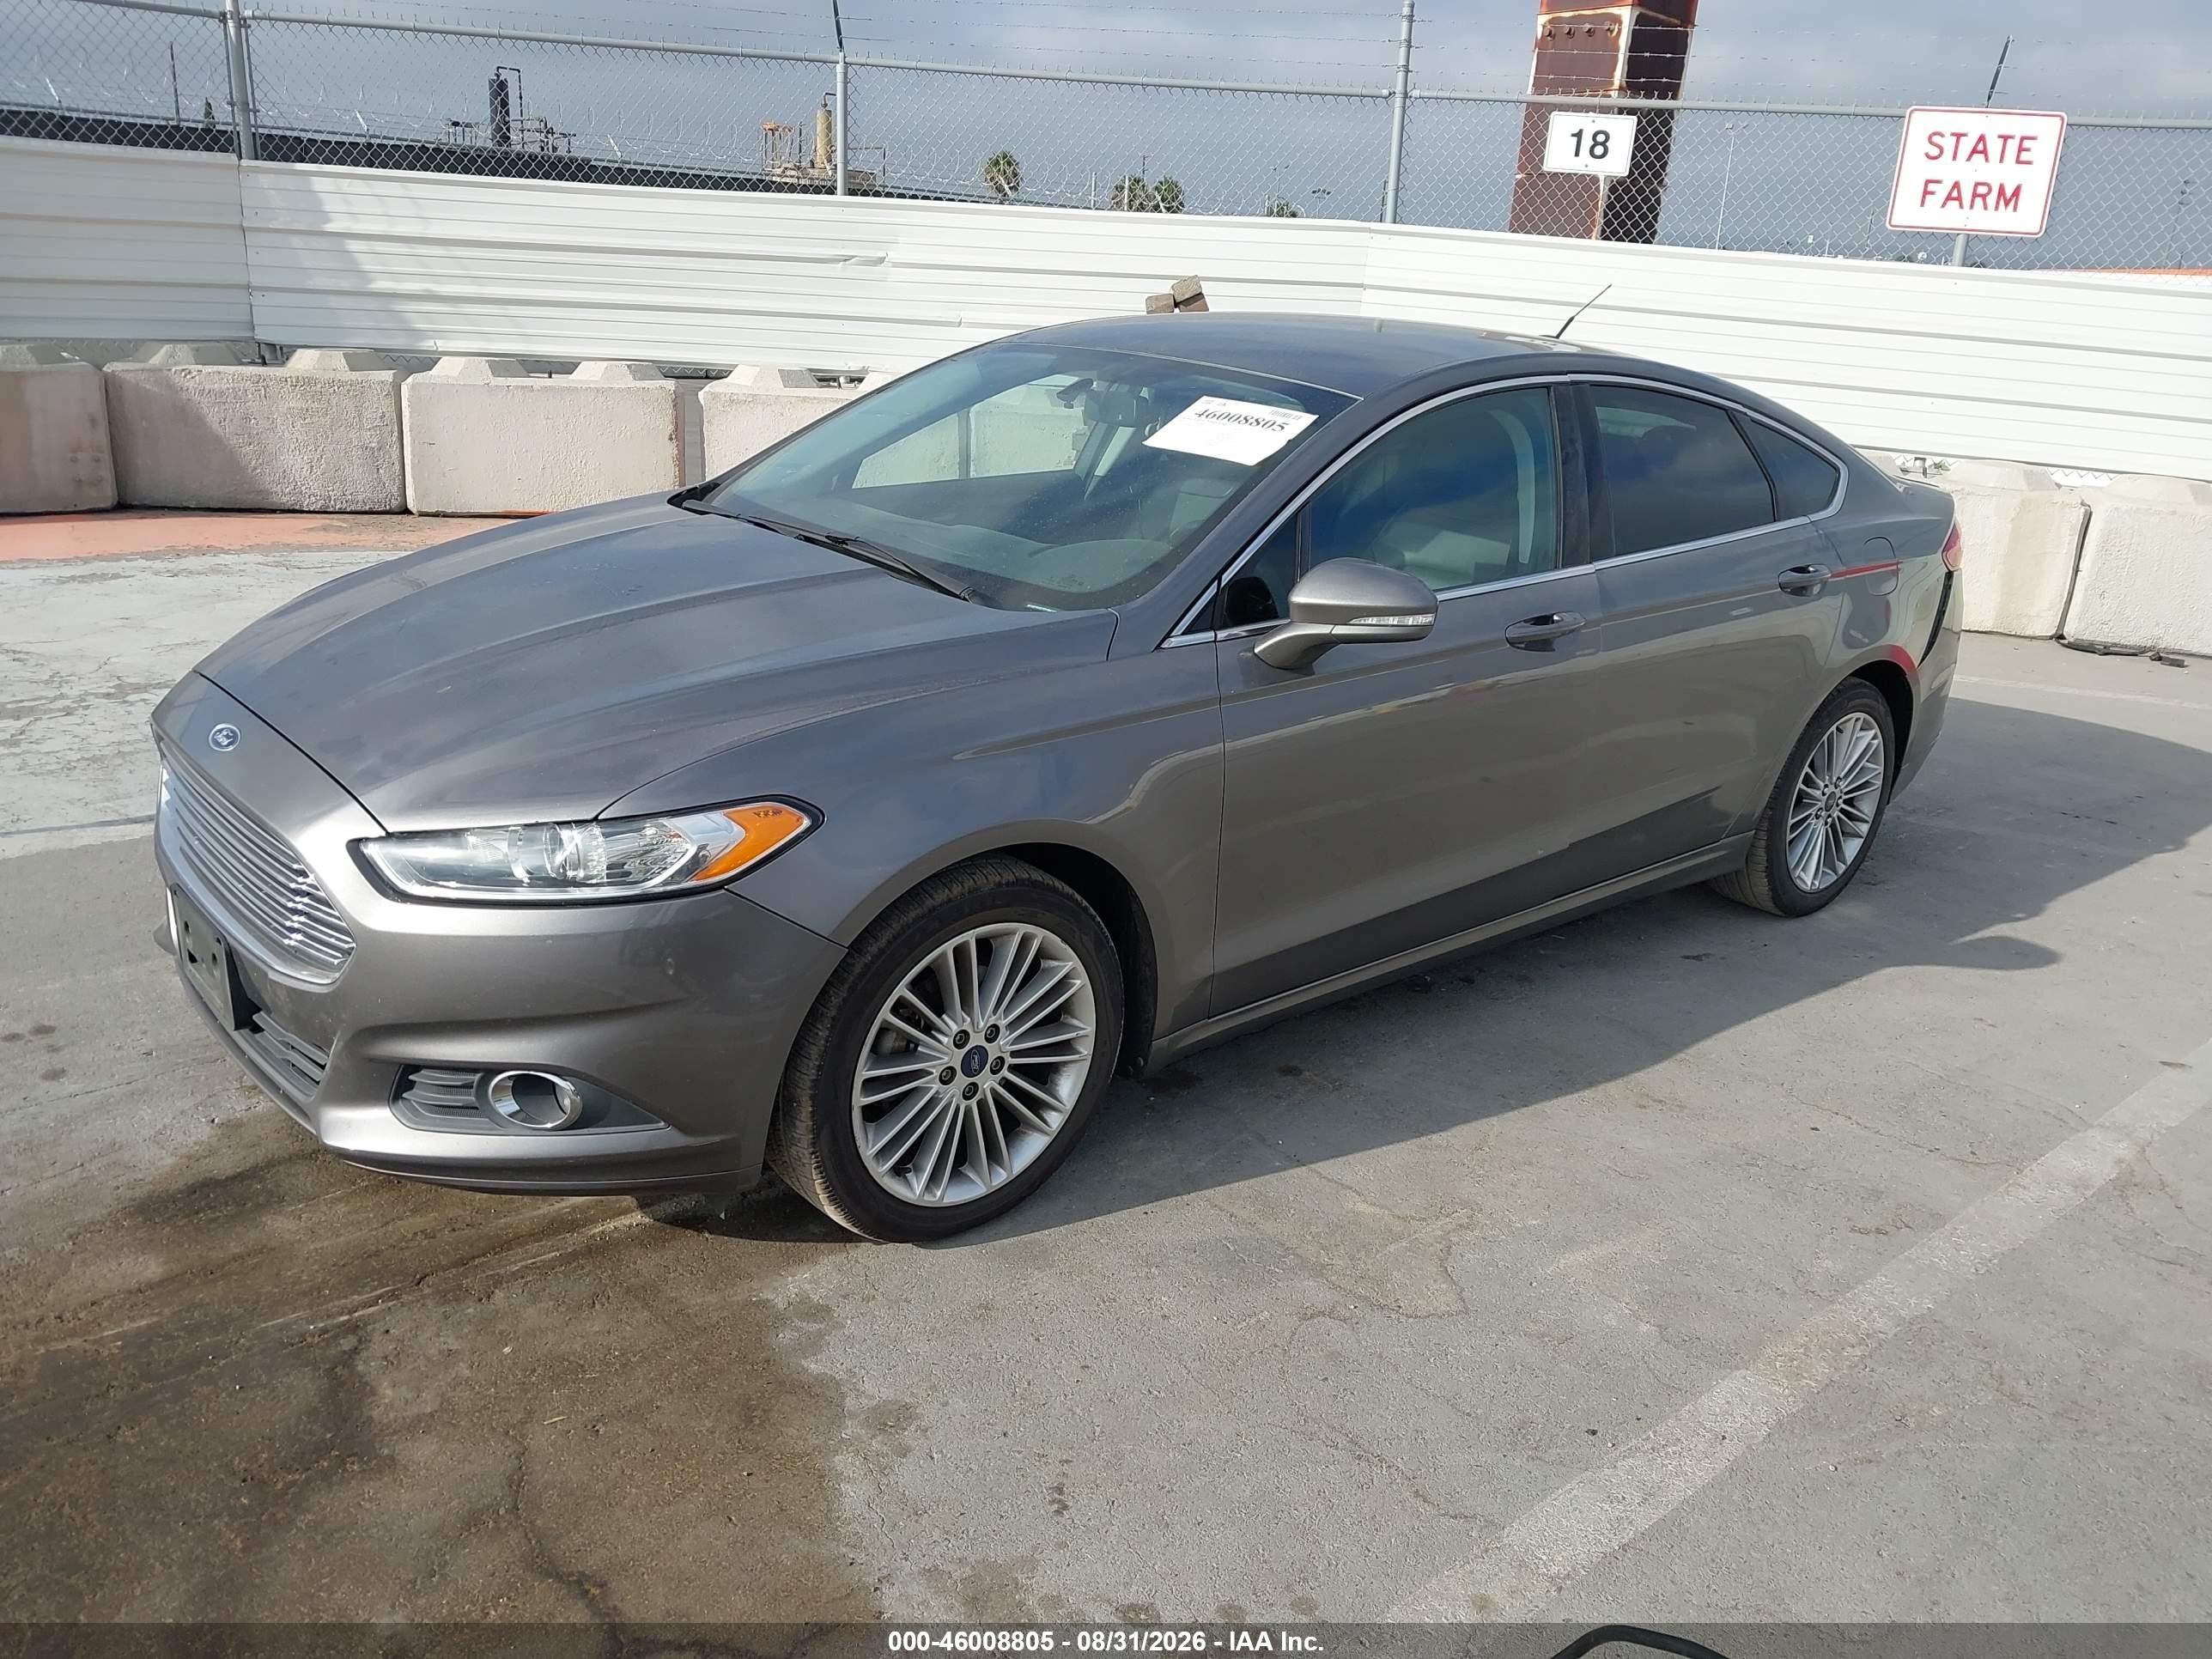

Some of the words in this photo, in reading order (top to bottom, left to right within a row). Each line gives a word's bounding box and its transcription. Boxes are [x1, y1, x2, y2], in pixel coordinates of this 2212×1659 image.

[1570, 129, 1610, 161] 18
[1923, 131, 2039, 167] STATE
[1920, 179, 2023, 213] FARM
[1195, 409, 1290, 432] 46008805
